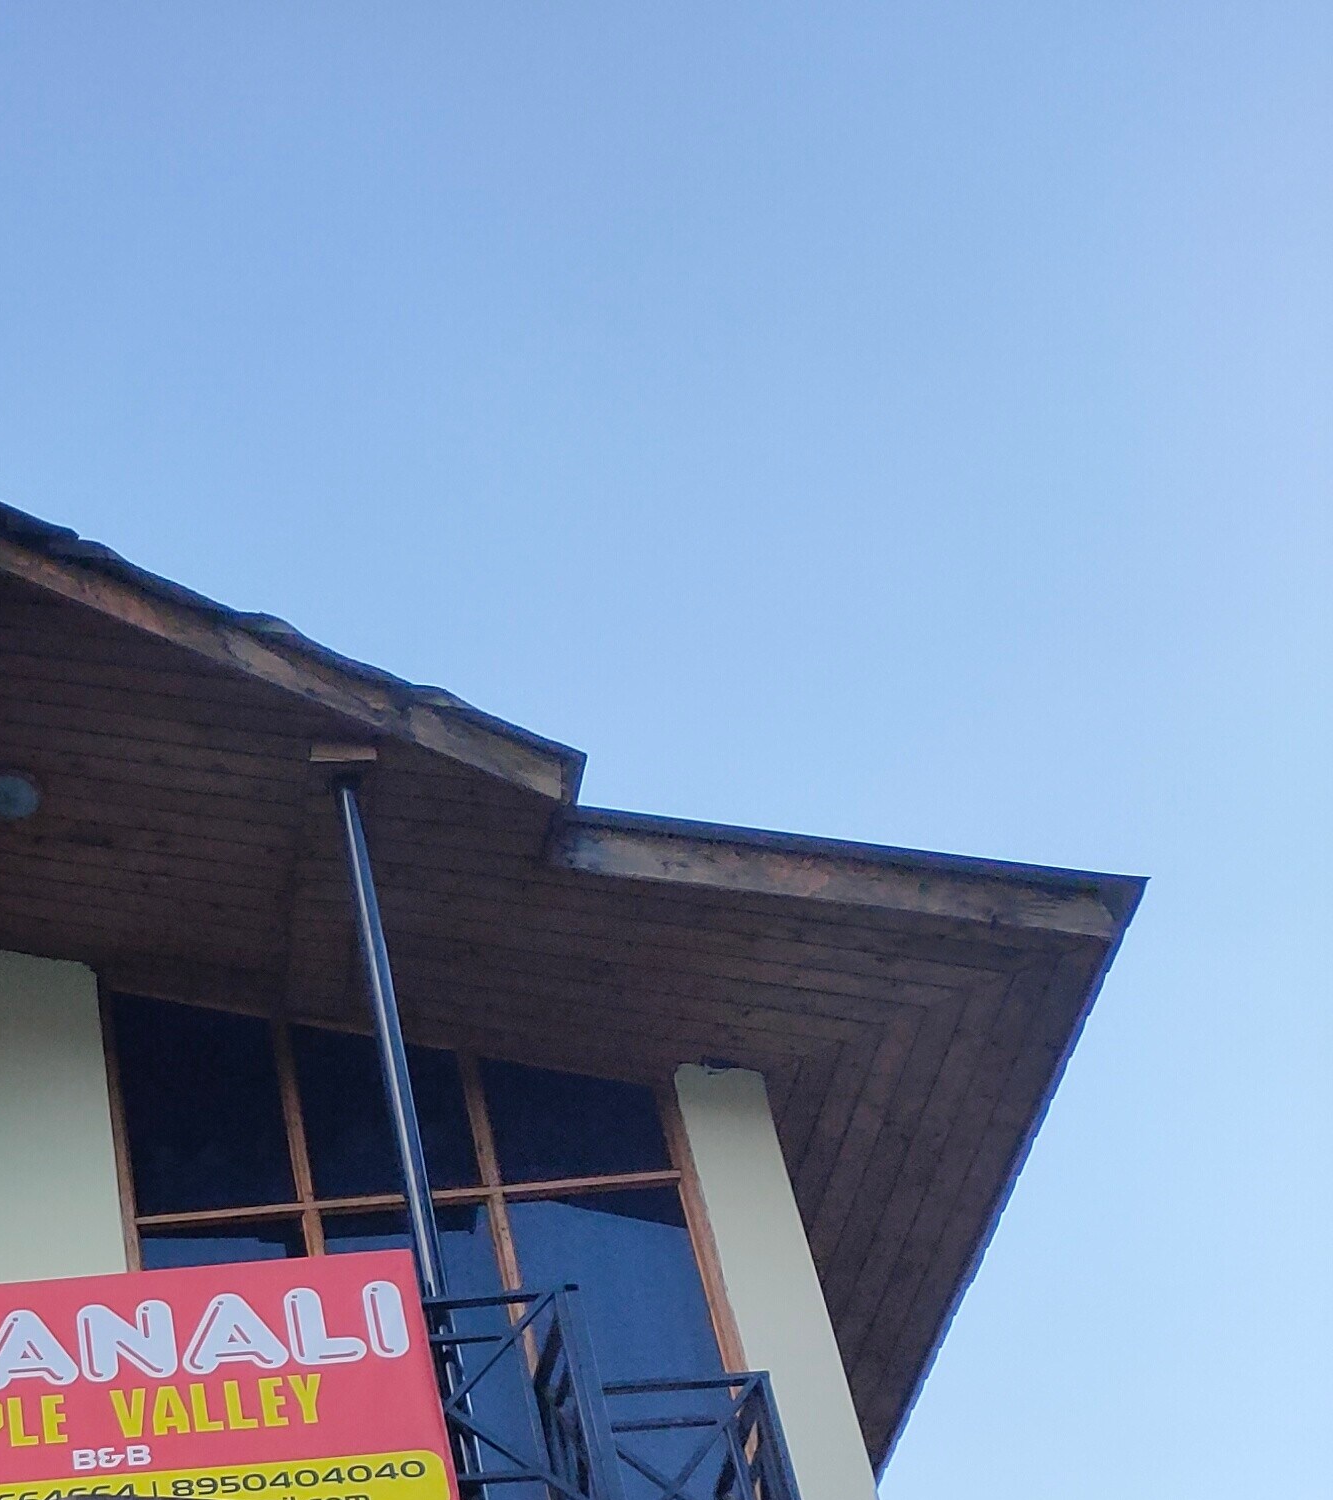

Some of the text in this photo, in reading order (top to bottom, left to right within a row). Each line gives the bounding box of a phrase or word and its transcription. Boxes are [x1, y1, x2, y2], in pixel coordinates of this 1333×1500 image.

[109, 1373, 322, 1439] VALLEY
[72, 1444, 152, 1470] B&B
[171, 1460, 426, 1497] 8950404040
